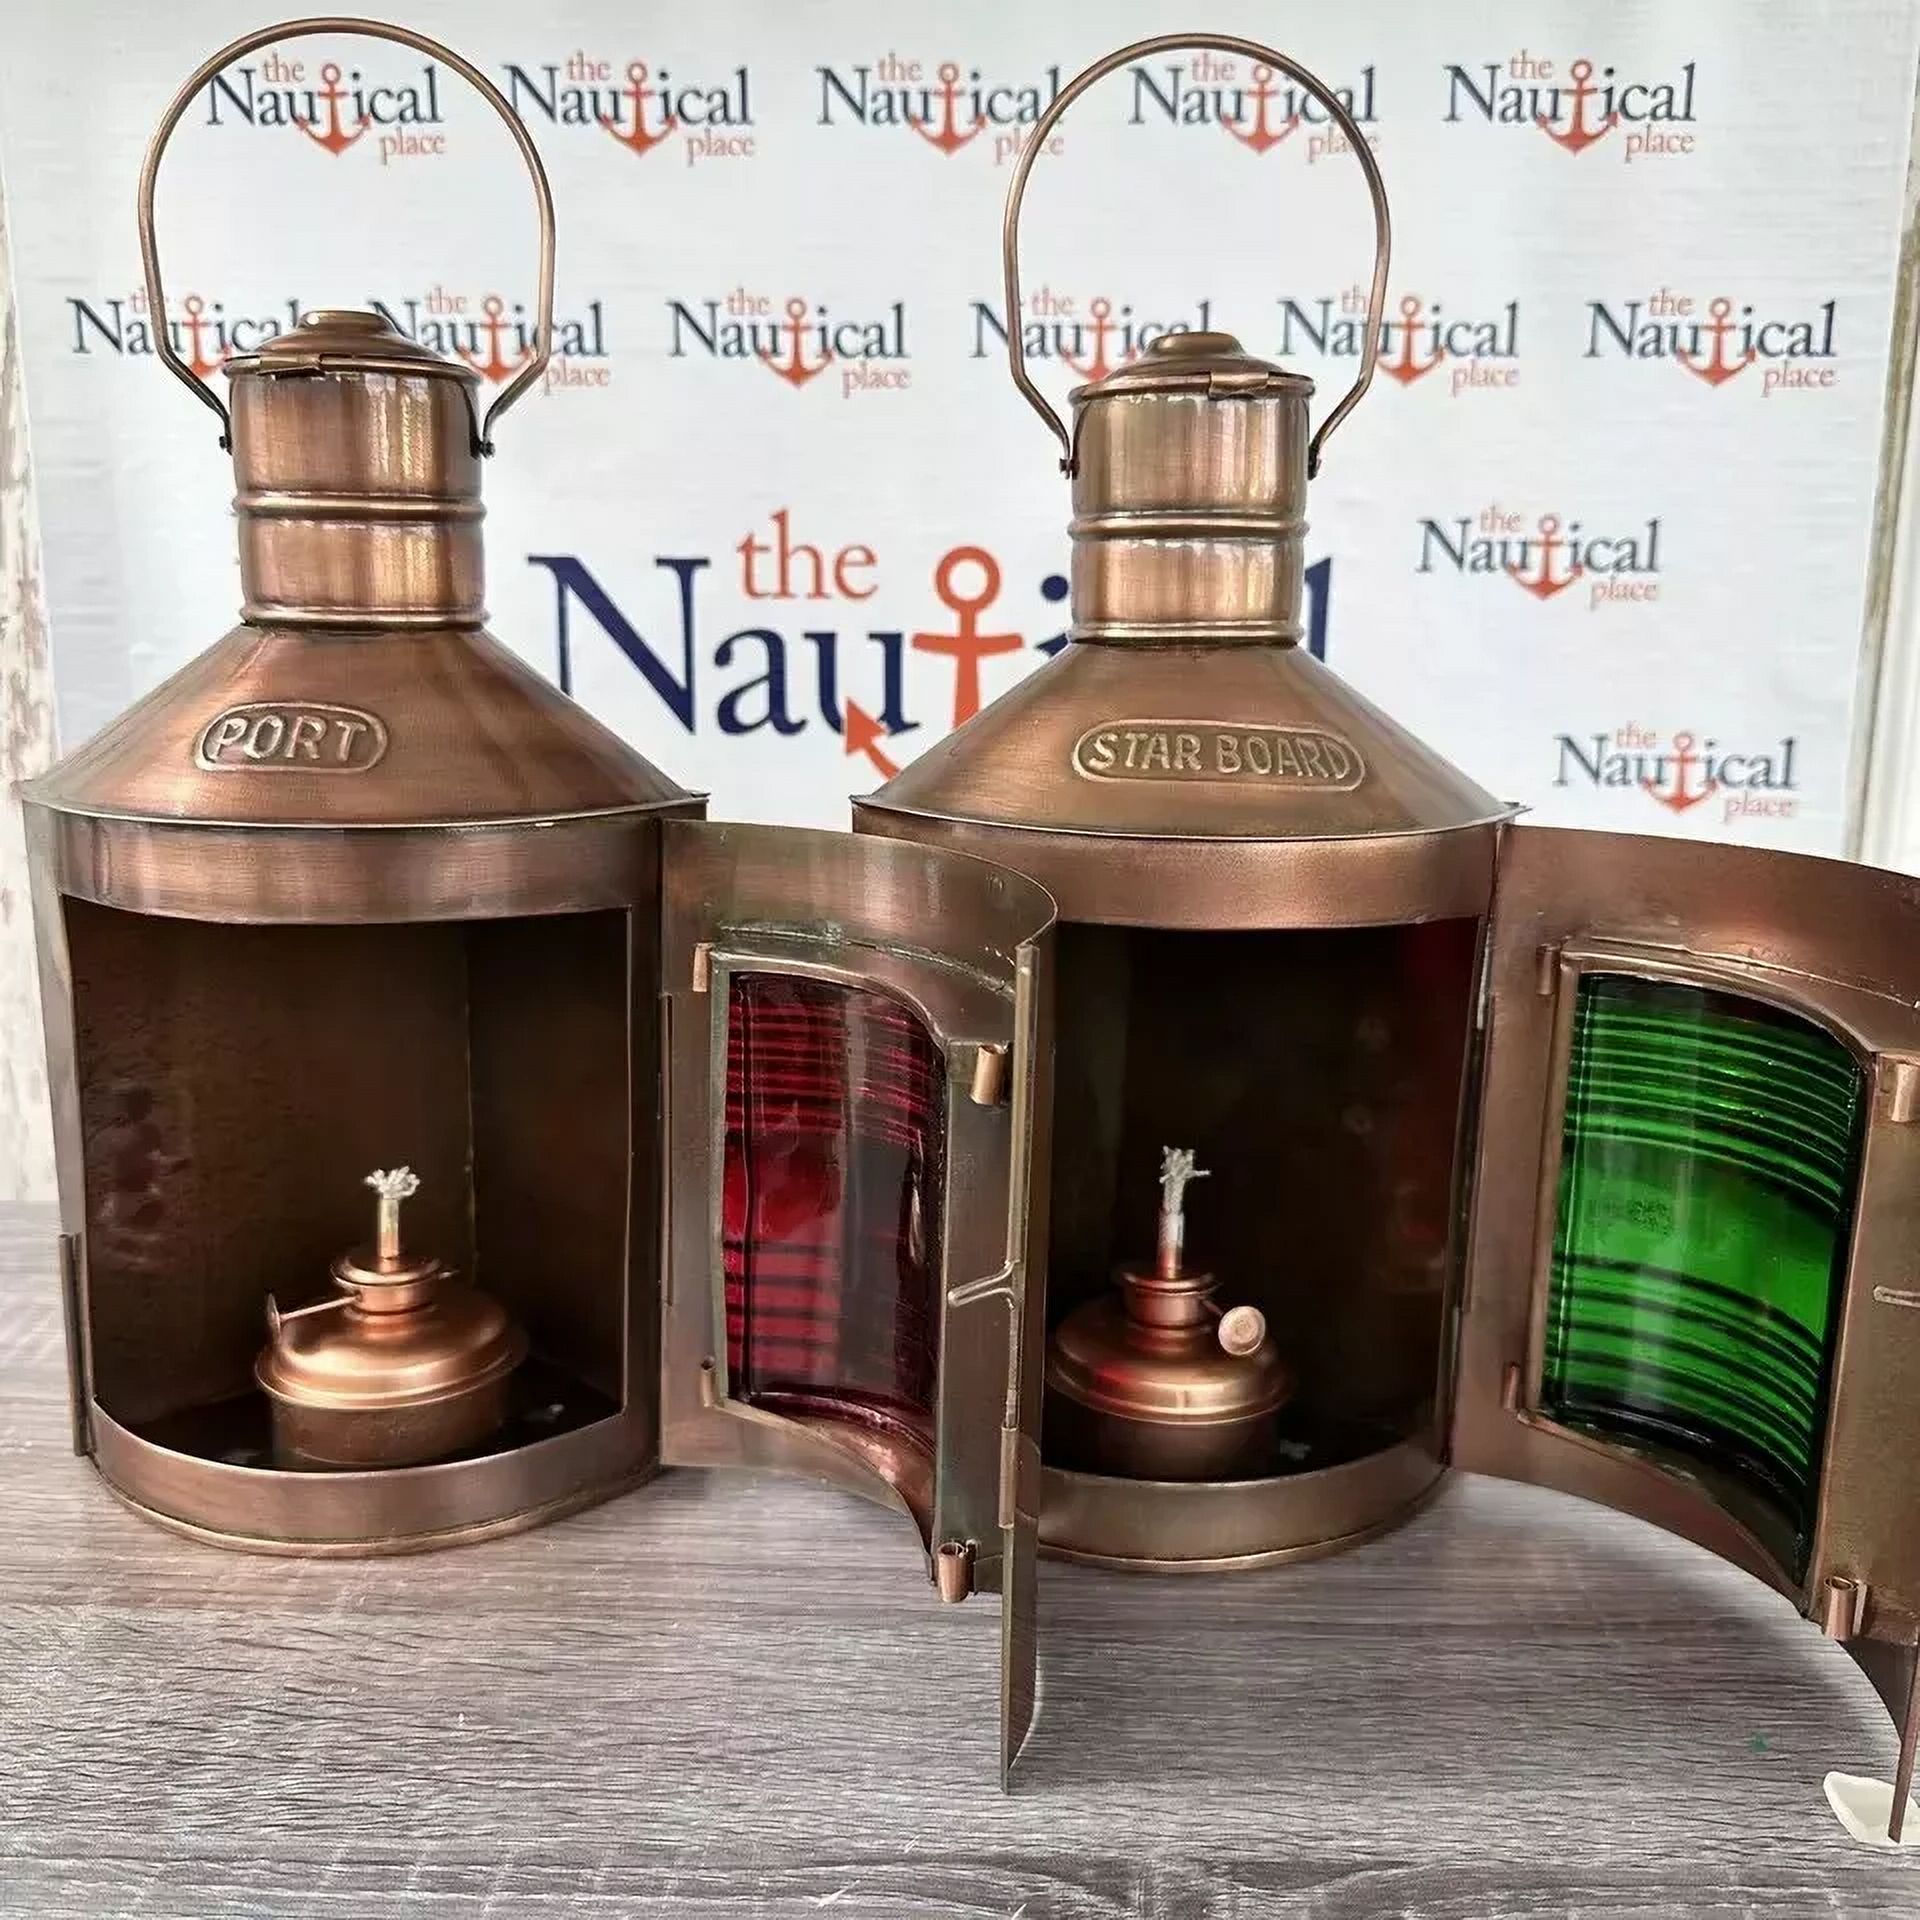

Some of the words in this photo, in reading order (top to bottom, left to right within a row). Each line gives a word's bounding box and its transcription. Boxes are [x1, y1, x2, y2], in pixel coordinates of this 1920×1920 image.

[263, 52, 305, 83] the
[567, 50, 611, 82] the
[878, 50, 922, 82] the
[1191, 52, 1237, 83] the
[1510, 49, 1553, 80] the
[206, 64, 445, 156] Nautical
[501, 62, 755, 157] Nautical
[1442, 58, 1697, 156] Nautical
[379, 127, 447, 166] place
[686, 127, 756, 167] place
[994, 127, 1064, 166] ple
[1308, 126, 1380, 164] plae
[1624, 124, 1696, 164] place
[425, 285, 466, 315] the
[727, 286, 770, 317] the
[1031, 285, 1074, 316] the
[1648, 288, 1693, 317] the
[665, 298, 911, 388] Nautical
[1583, 299, 1838, 387] Nautical
[545, 357, 611, 396] place
[842, 361, 912, 400] place
[1452, 360, 1521, 397] place
[1761, 361, 1836, 398] place
[1480, 505, 1522, 533] the
[736, 508, 879, 601] the
[1415, 514, 1662, 600] Nautical
[1590, 576, 1658, 610] place
[207, 715, 367, 761] PORT
[1616, 721, 1657, 748] the
[1087, 732, 1202, 770] STAR
[1216, 733, 1352, 779] BOARD
[1552, 733, 1800, 814] Nautical
[1722, 790, 1795, 824] place
